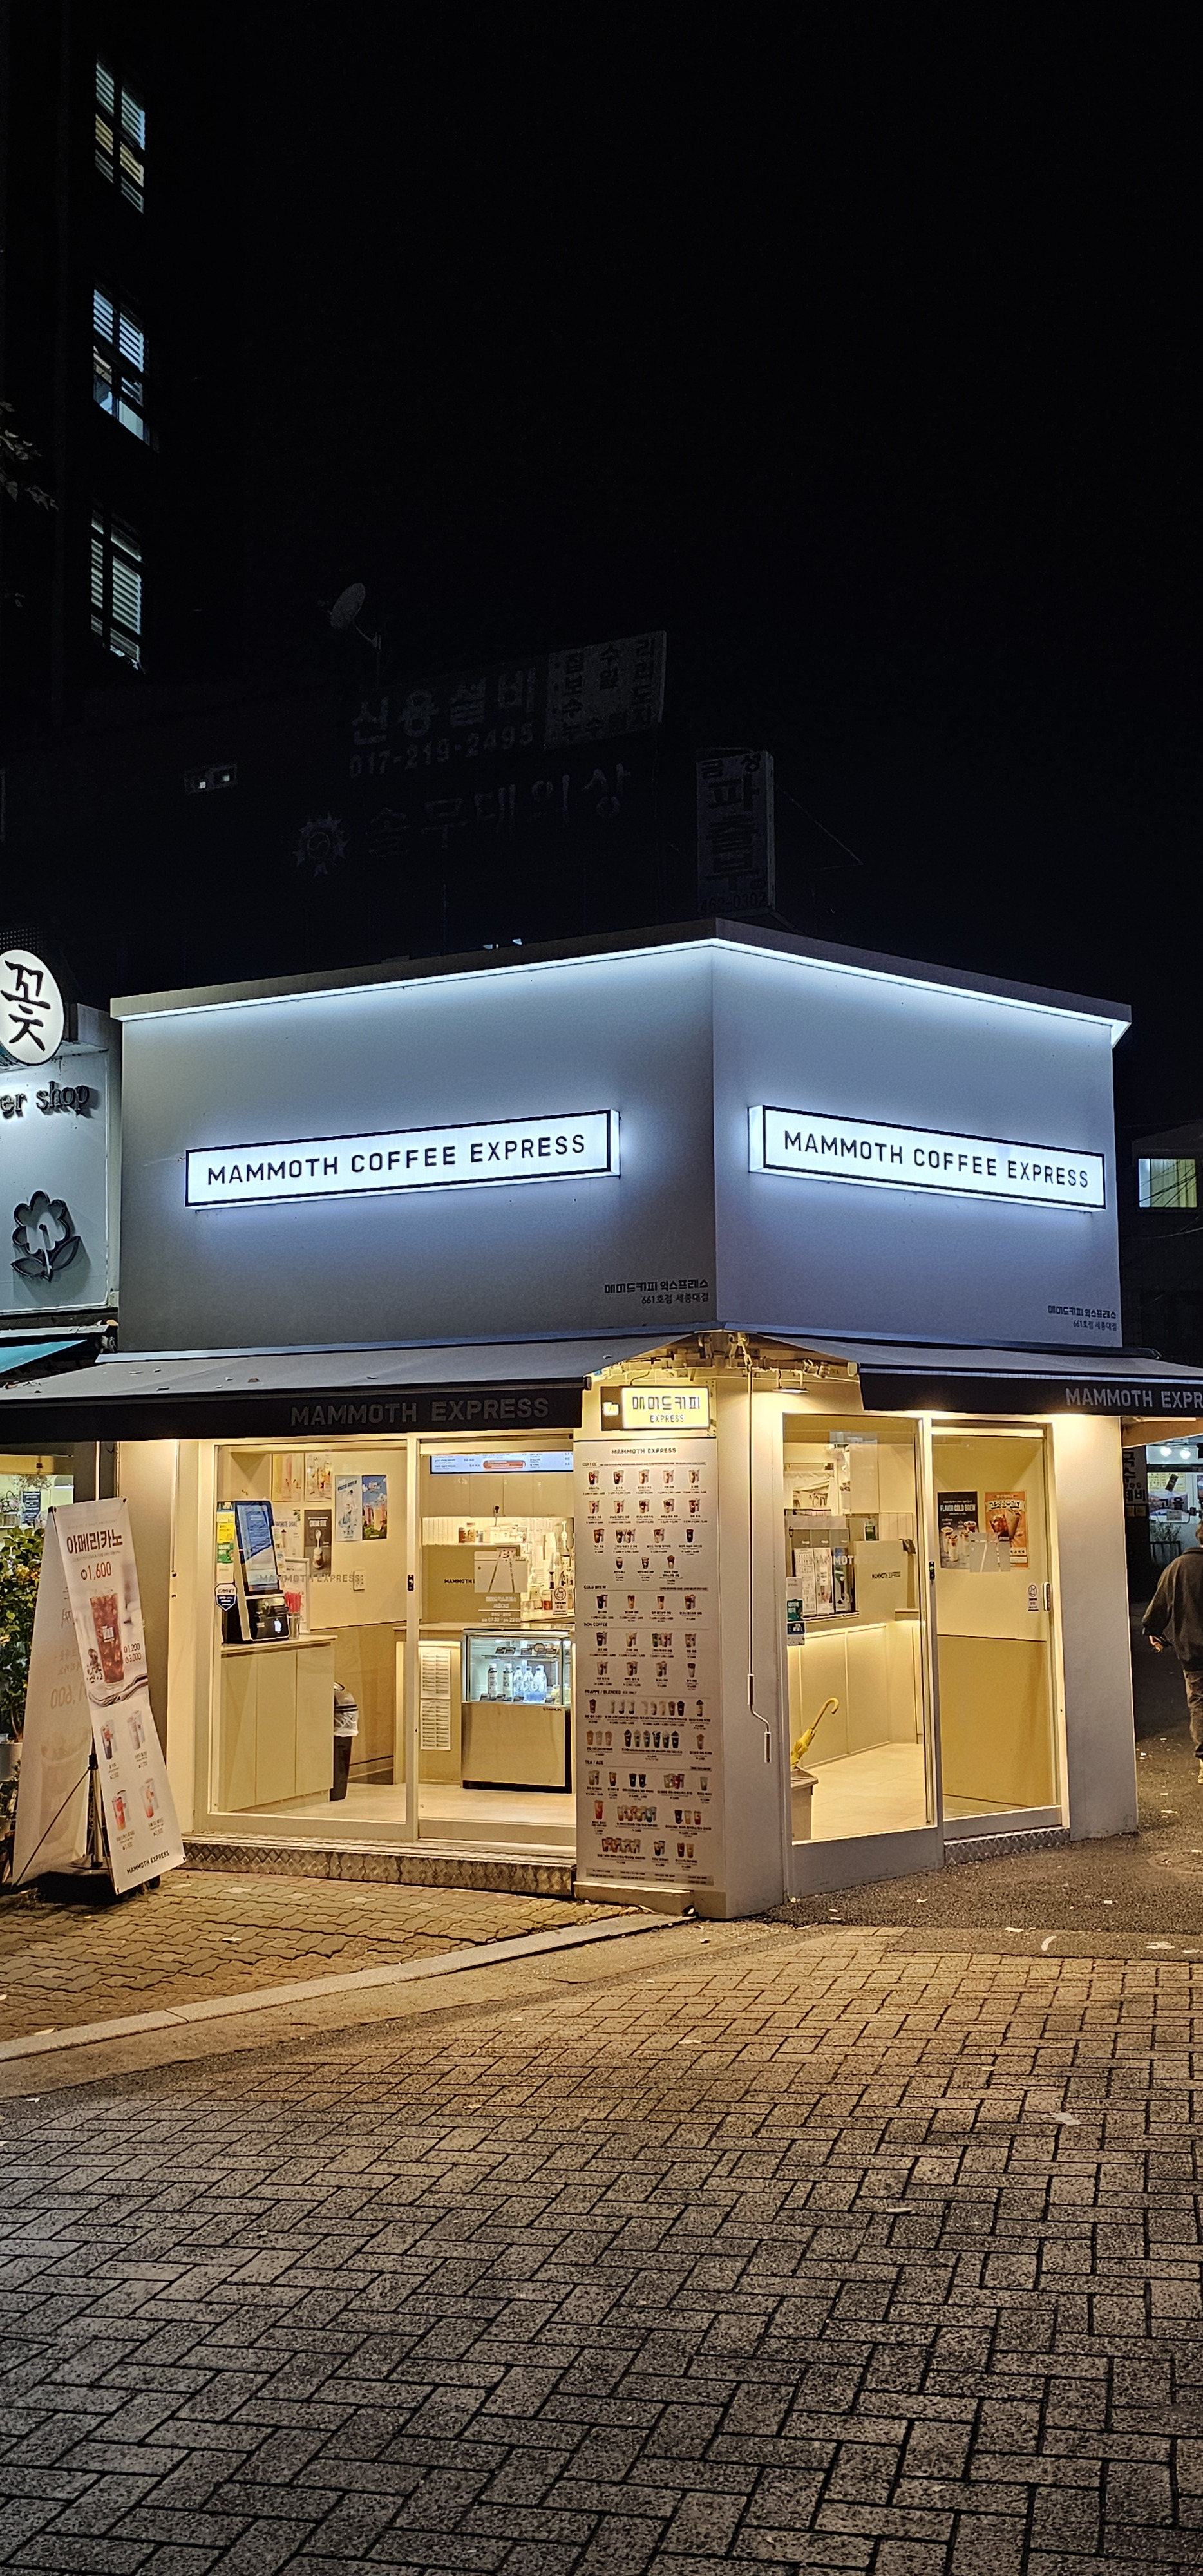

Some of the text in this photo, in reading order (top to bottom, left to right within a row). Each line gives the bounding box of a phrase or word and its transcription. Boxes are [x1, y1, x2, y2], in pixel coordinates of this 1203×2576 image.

[351, 667, 536, 746] 신용설비
[349, 720, 534, 778] 017-219-2495
[1, 960, 51, 1051] 꽃
[37, 1081, 90, 1115] shop
[208, 1134, 585, 1185] MAMMOTH COFFEE EXPRESS
[784, 1130, 1088, 1188] MAMMOTH COFFEE EXPRESS
[659, 1279, 708, 1291] 익스프레스
[641, 1293, 708, 1304] 661호점 세종대점
[1084, 1309, 1116, 1319] 익스프레스
[1066, 1388, 1153, 1407] MAMMOTH
[291, 1397, 549, 1426] MAMMOTH EXPRESS
[650, 1414, 685, 1423] EXPRESS
[66, 1530, 123, 1555] 아메리카노
[317, 1574, 360, 1582] EXPRESS
[126, 1850, 169, 1875] MAMMOTH EXPRESS
